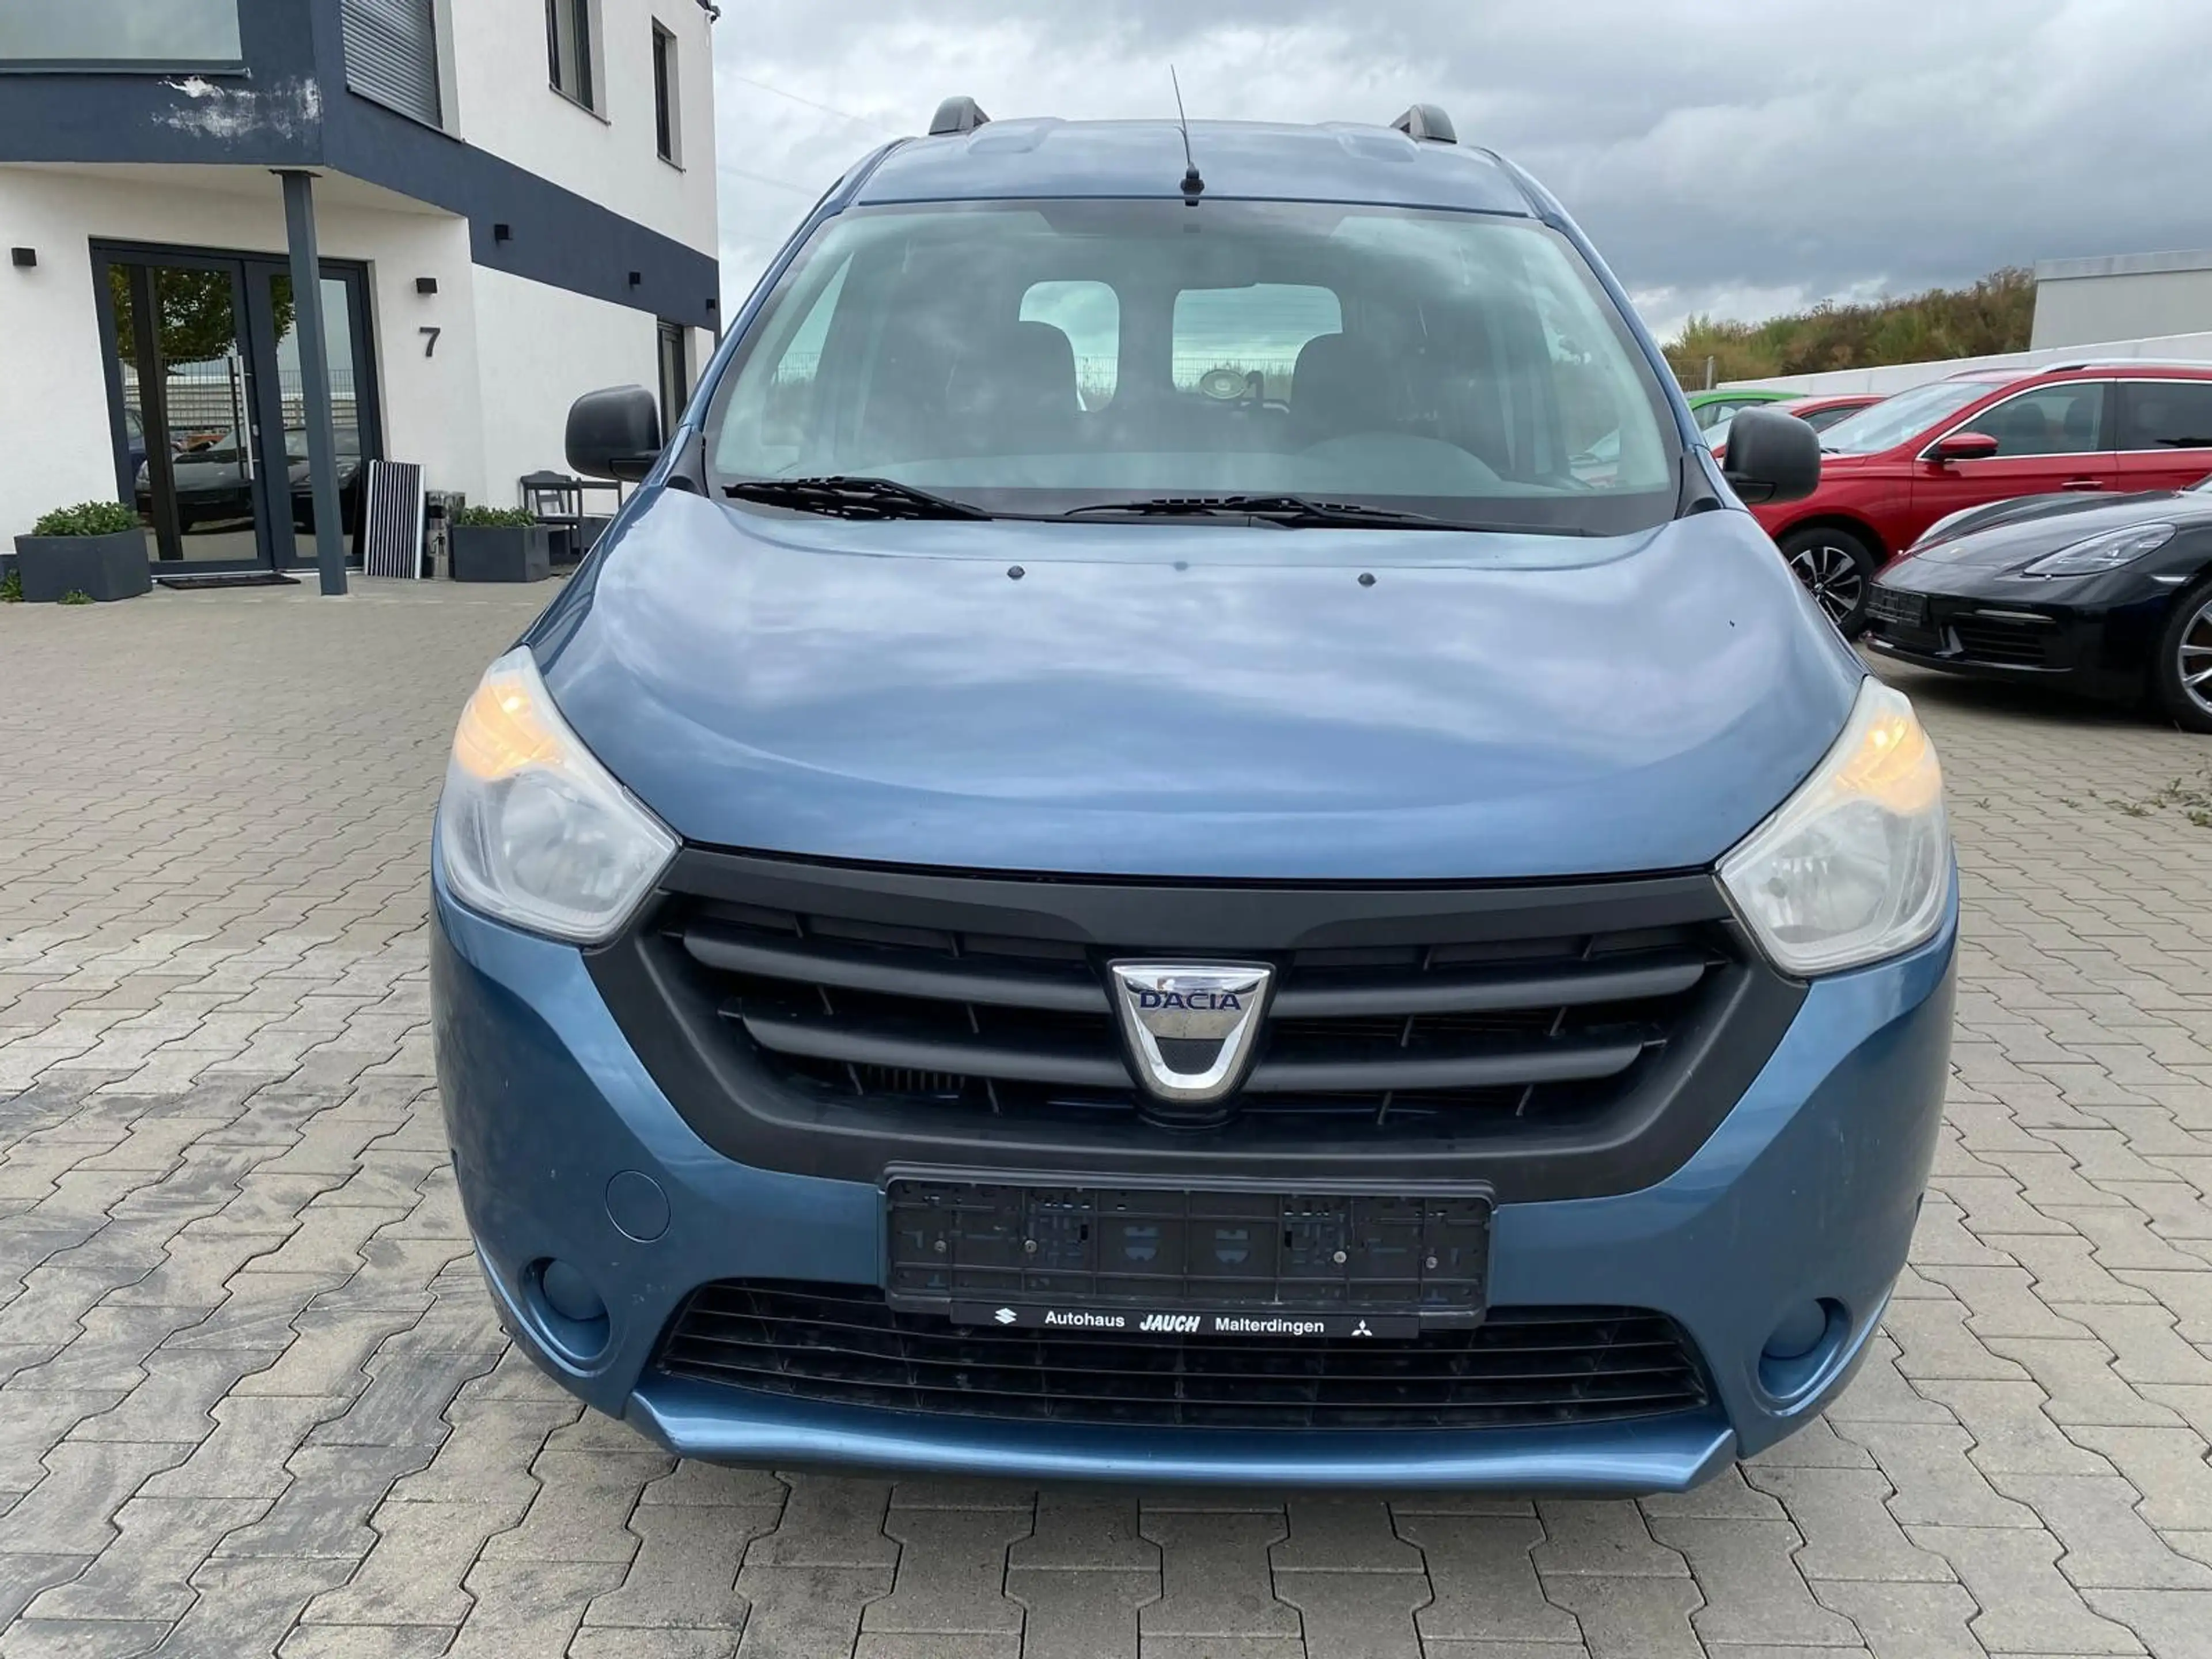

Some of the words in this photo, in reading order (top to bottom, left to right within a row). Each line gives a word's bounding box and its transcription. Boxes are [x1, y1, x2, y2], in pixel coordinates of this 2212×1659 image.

[419, 327, 440, 357] 7
[1140, 991, 1242, 1010] DACIA
[1045, 1310, 1125, 1327] Autohaus
[1139, 1315, 1201, 1332] JAUCH
[1215, 1317, 1324, 1336] Malterdingen
